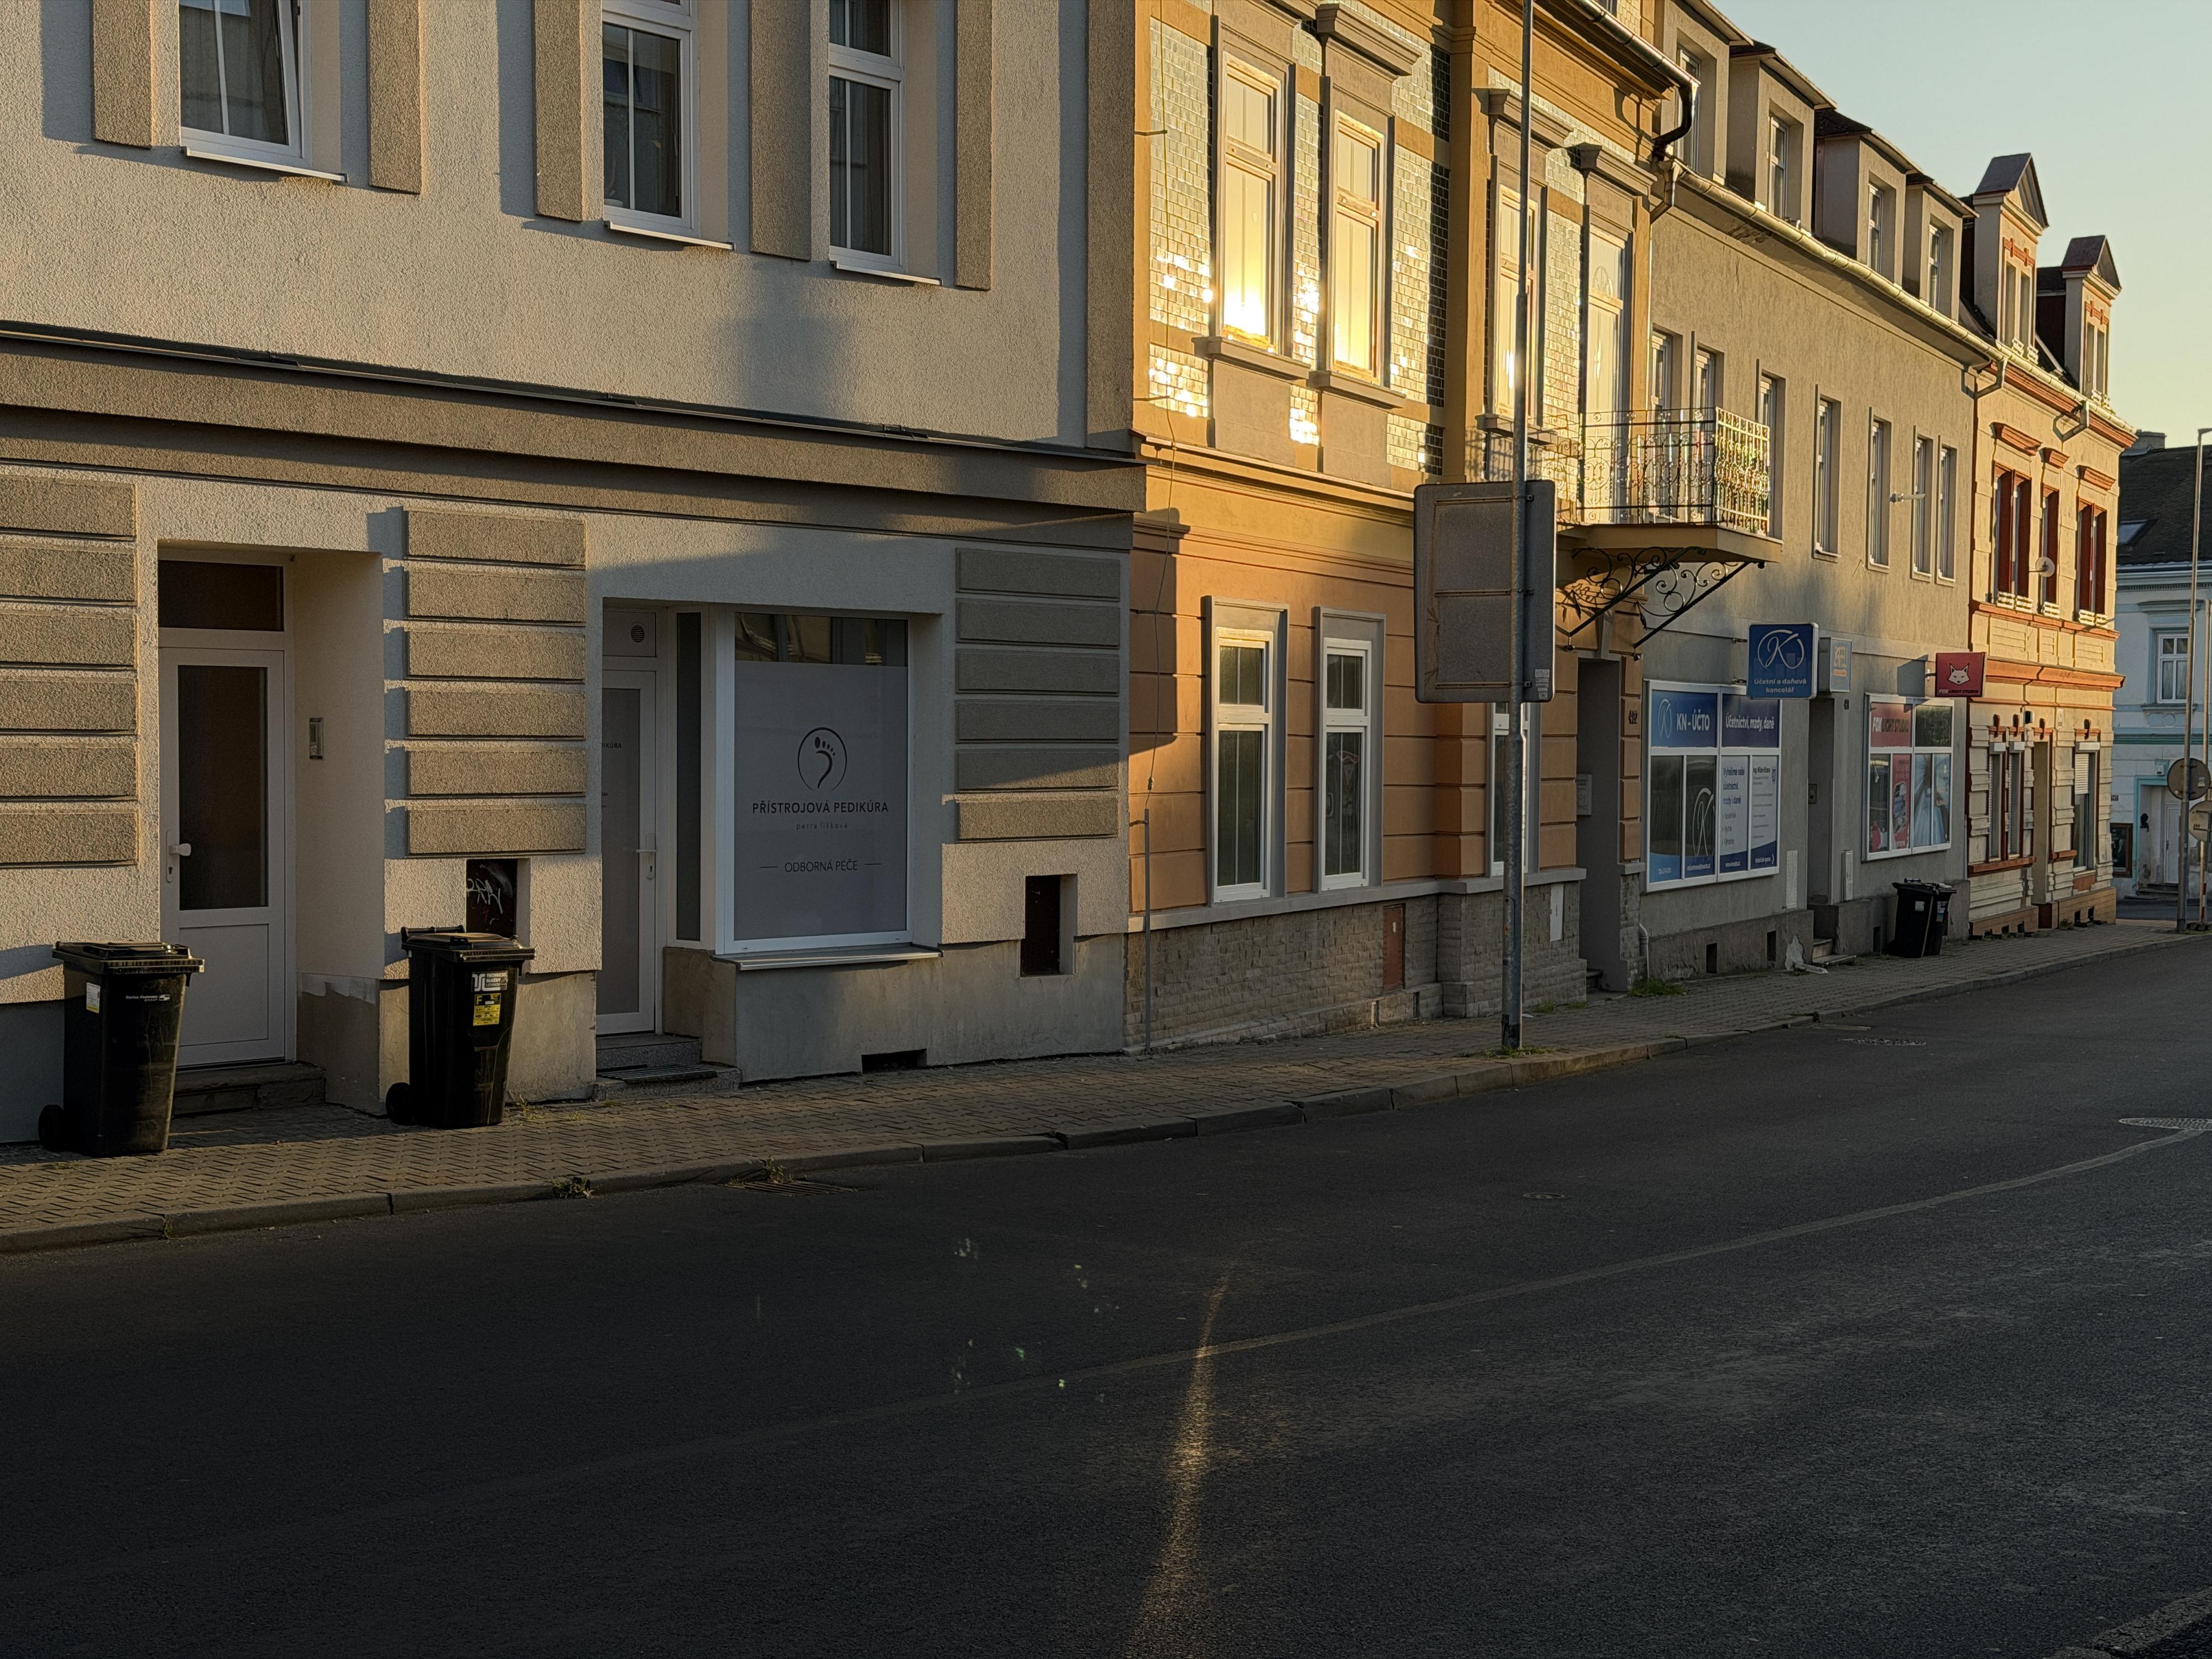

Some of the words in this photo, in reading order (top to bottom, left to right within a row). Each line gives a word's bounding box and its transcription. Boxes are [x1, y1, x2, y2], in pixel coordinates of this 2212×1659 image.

[1872, 717, 1882, 733] FOX
[753, 800, 830, 813] PŘÍSTROJOVÁ
[834, 800, 889, 813] PEDIKÚRA
[785, 859, 833, 872] ODBORNÁ
[836, 859, 858, 871] PÉČE
